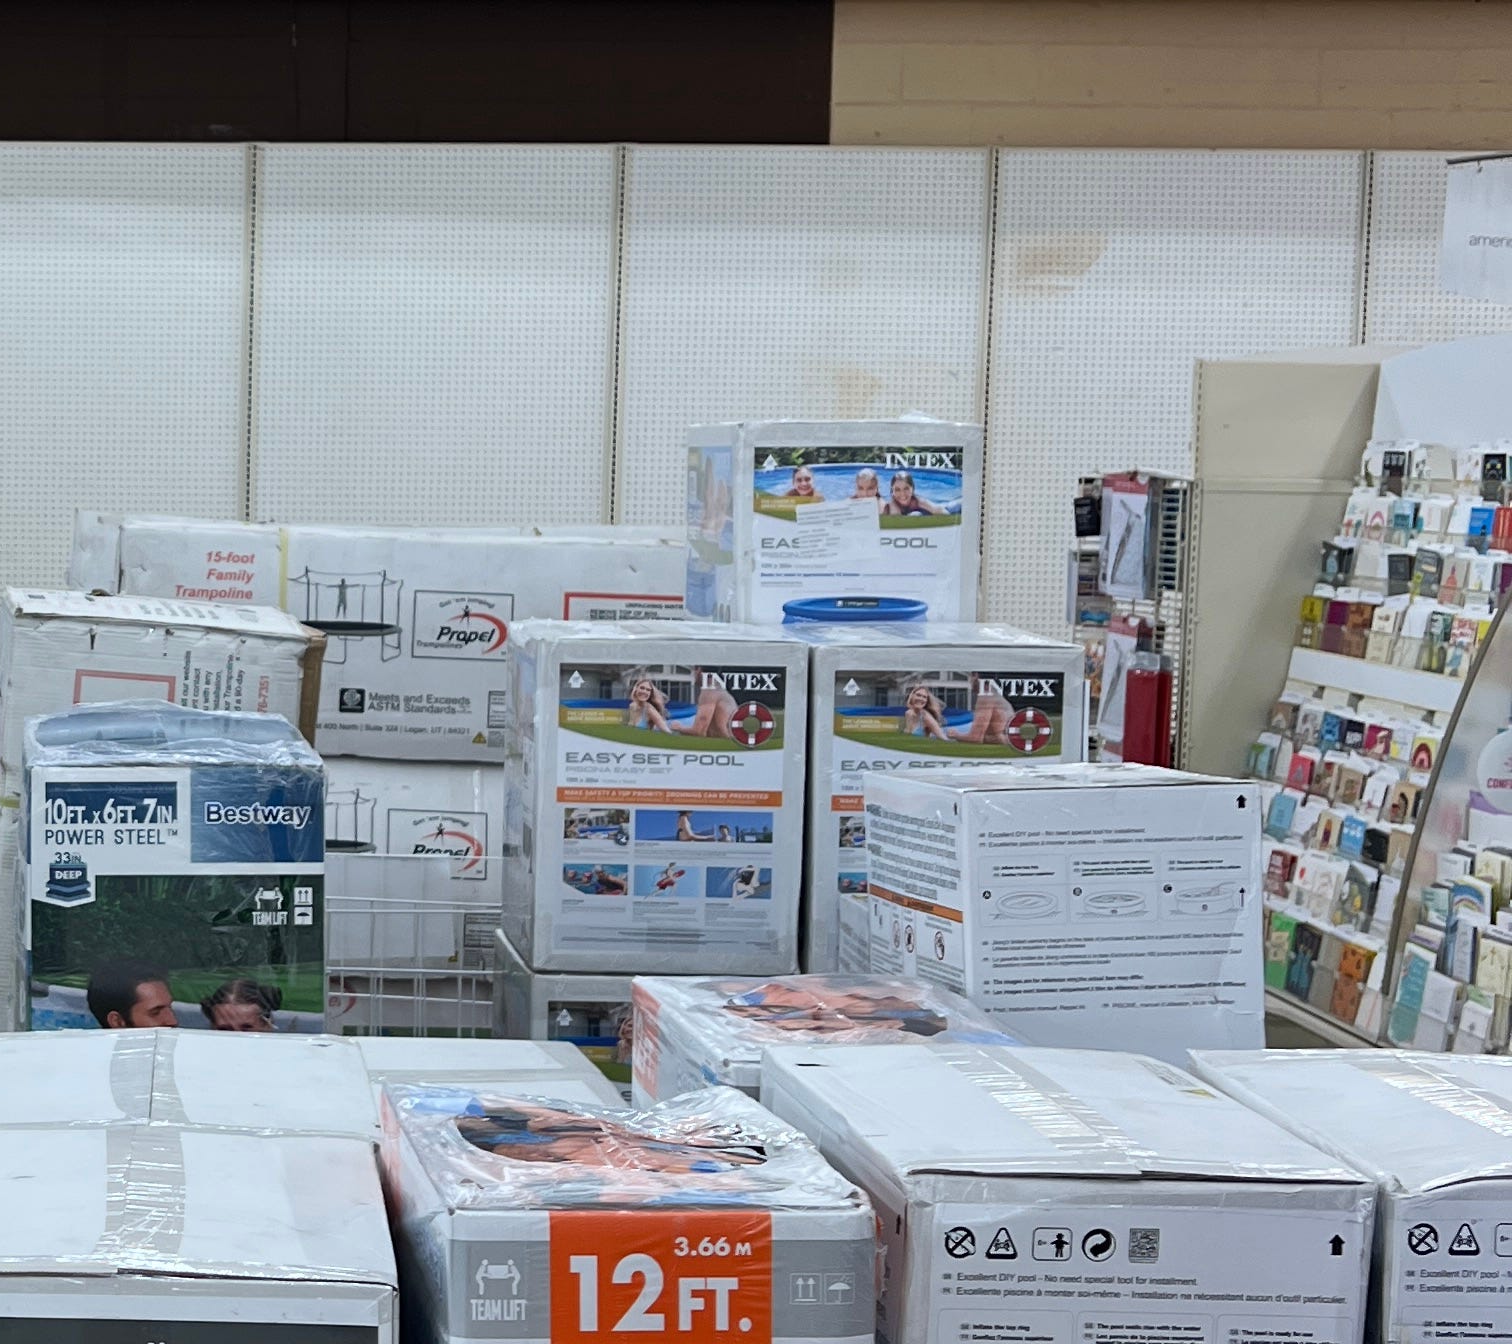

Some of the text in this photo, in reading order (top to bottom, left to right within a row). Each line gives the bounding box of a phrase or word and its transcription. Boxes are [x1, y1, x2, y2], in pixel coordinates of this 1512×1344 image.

[885, 453, 956, 468] INTEX
[761, 538, 800, 549] EAS
[207, 551, 255, 563] 15-foot
[207, 569, 254, 584] Family
[175, 585, 253, 600] Trampoline
[437, 626, 495, 645] Propel
[701, 672, 778, 691] INTEX
[978, 679, 1056, 697] INTEX
[403, 694, 423, 703] and
[426, 694, 470, 705] Exceeds
[368, 702, 456, 714] ASTM Standards
[565, 752, 744, 766] EASY SET POOL
[841, 760, 903, 771] EASY
[45, 798, 88, 824] 10FT.
[103, 798, 137, 824] 6FT.
[204, 801, 311, 829] Bestway
[45, 829, 104, 845] POWER
[55, 870, 82, 880] DEEP
[673, 1236, 752, 1256] 3.66 M
[957, 1273, 1147, 1285] Excellent DIY pool No need special tool for
[569, 1253, 752, 1332] 12 FT.
[470, 1299, 528, 1321] TEAM LIFT
